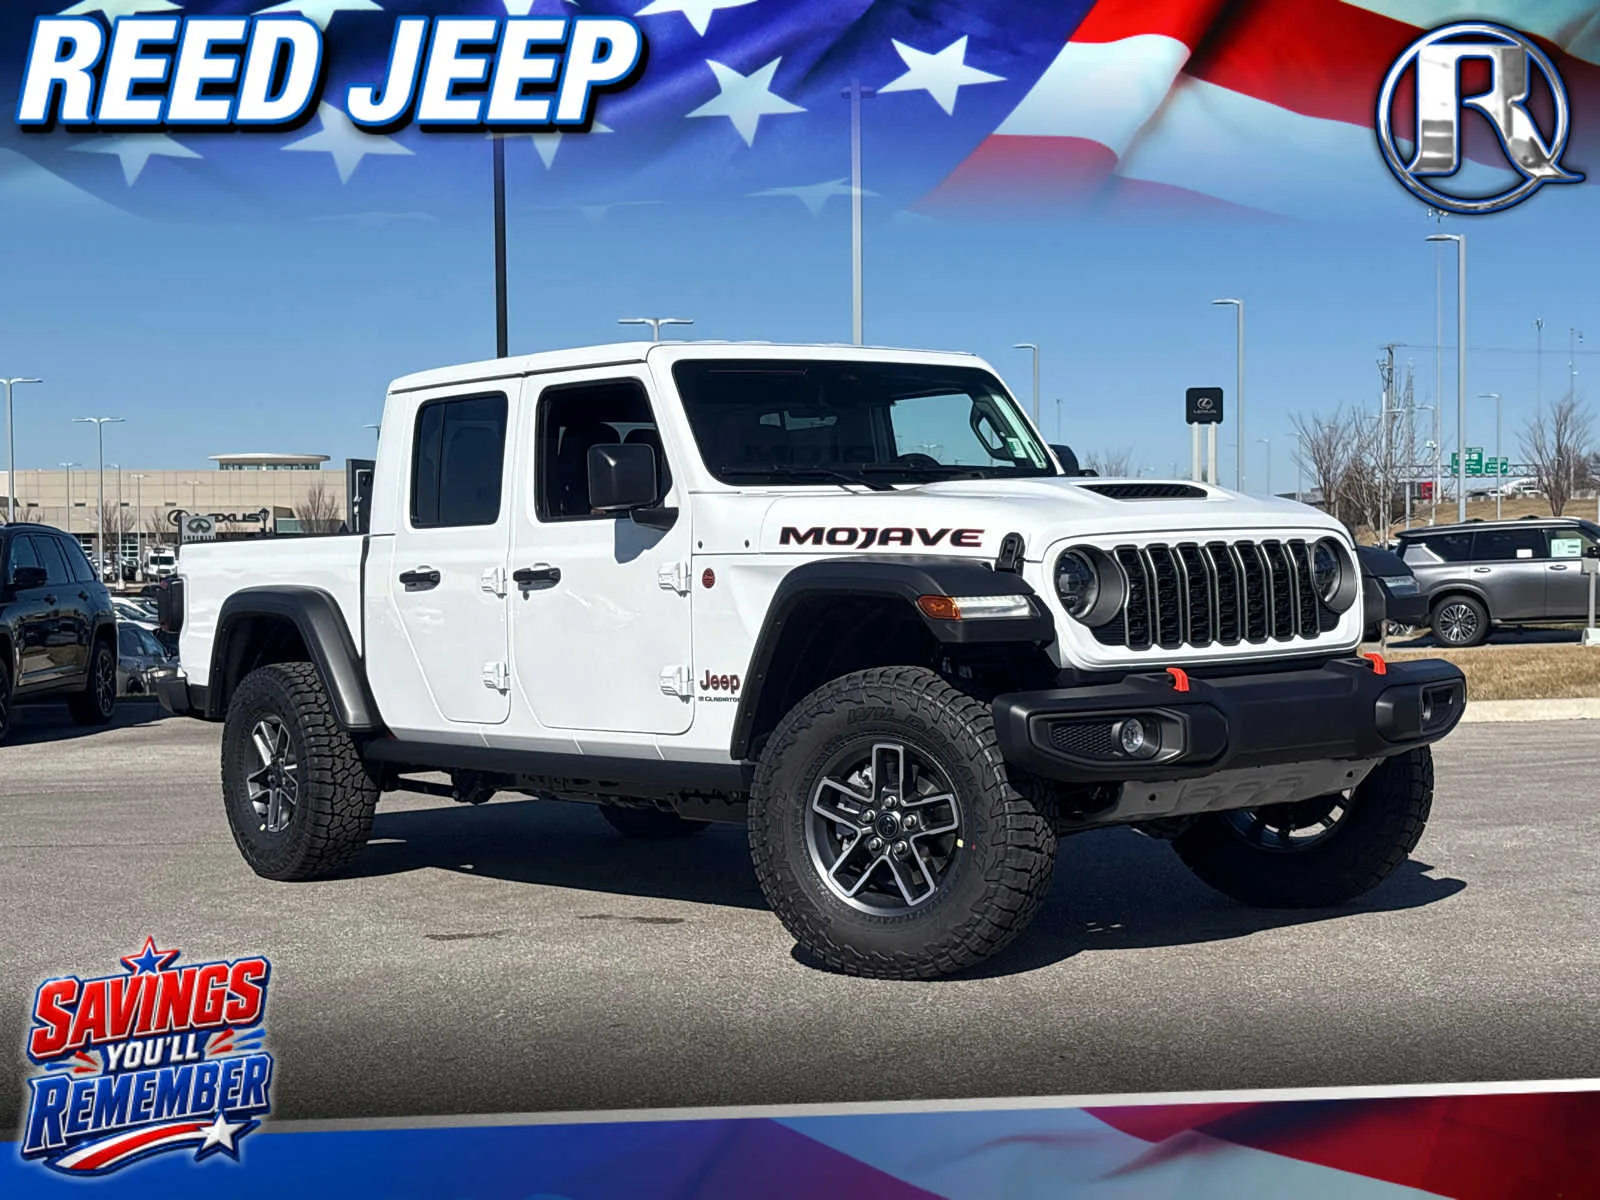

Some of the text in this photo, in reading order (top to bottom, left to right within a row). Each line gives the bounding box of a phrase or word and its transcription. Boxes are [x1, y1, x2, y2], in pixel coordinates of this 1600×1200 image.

[195, 513, 262, 523] EXUS
[779, 526, 986, 550] MOJAVE
[700, 669, 741, 694] Jeep
